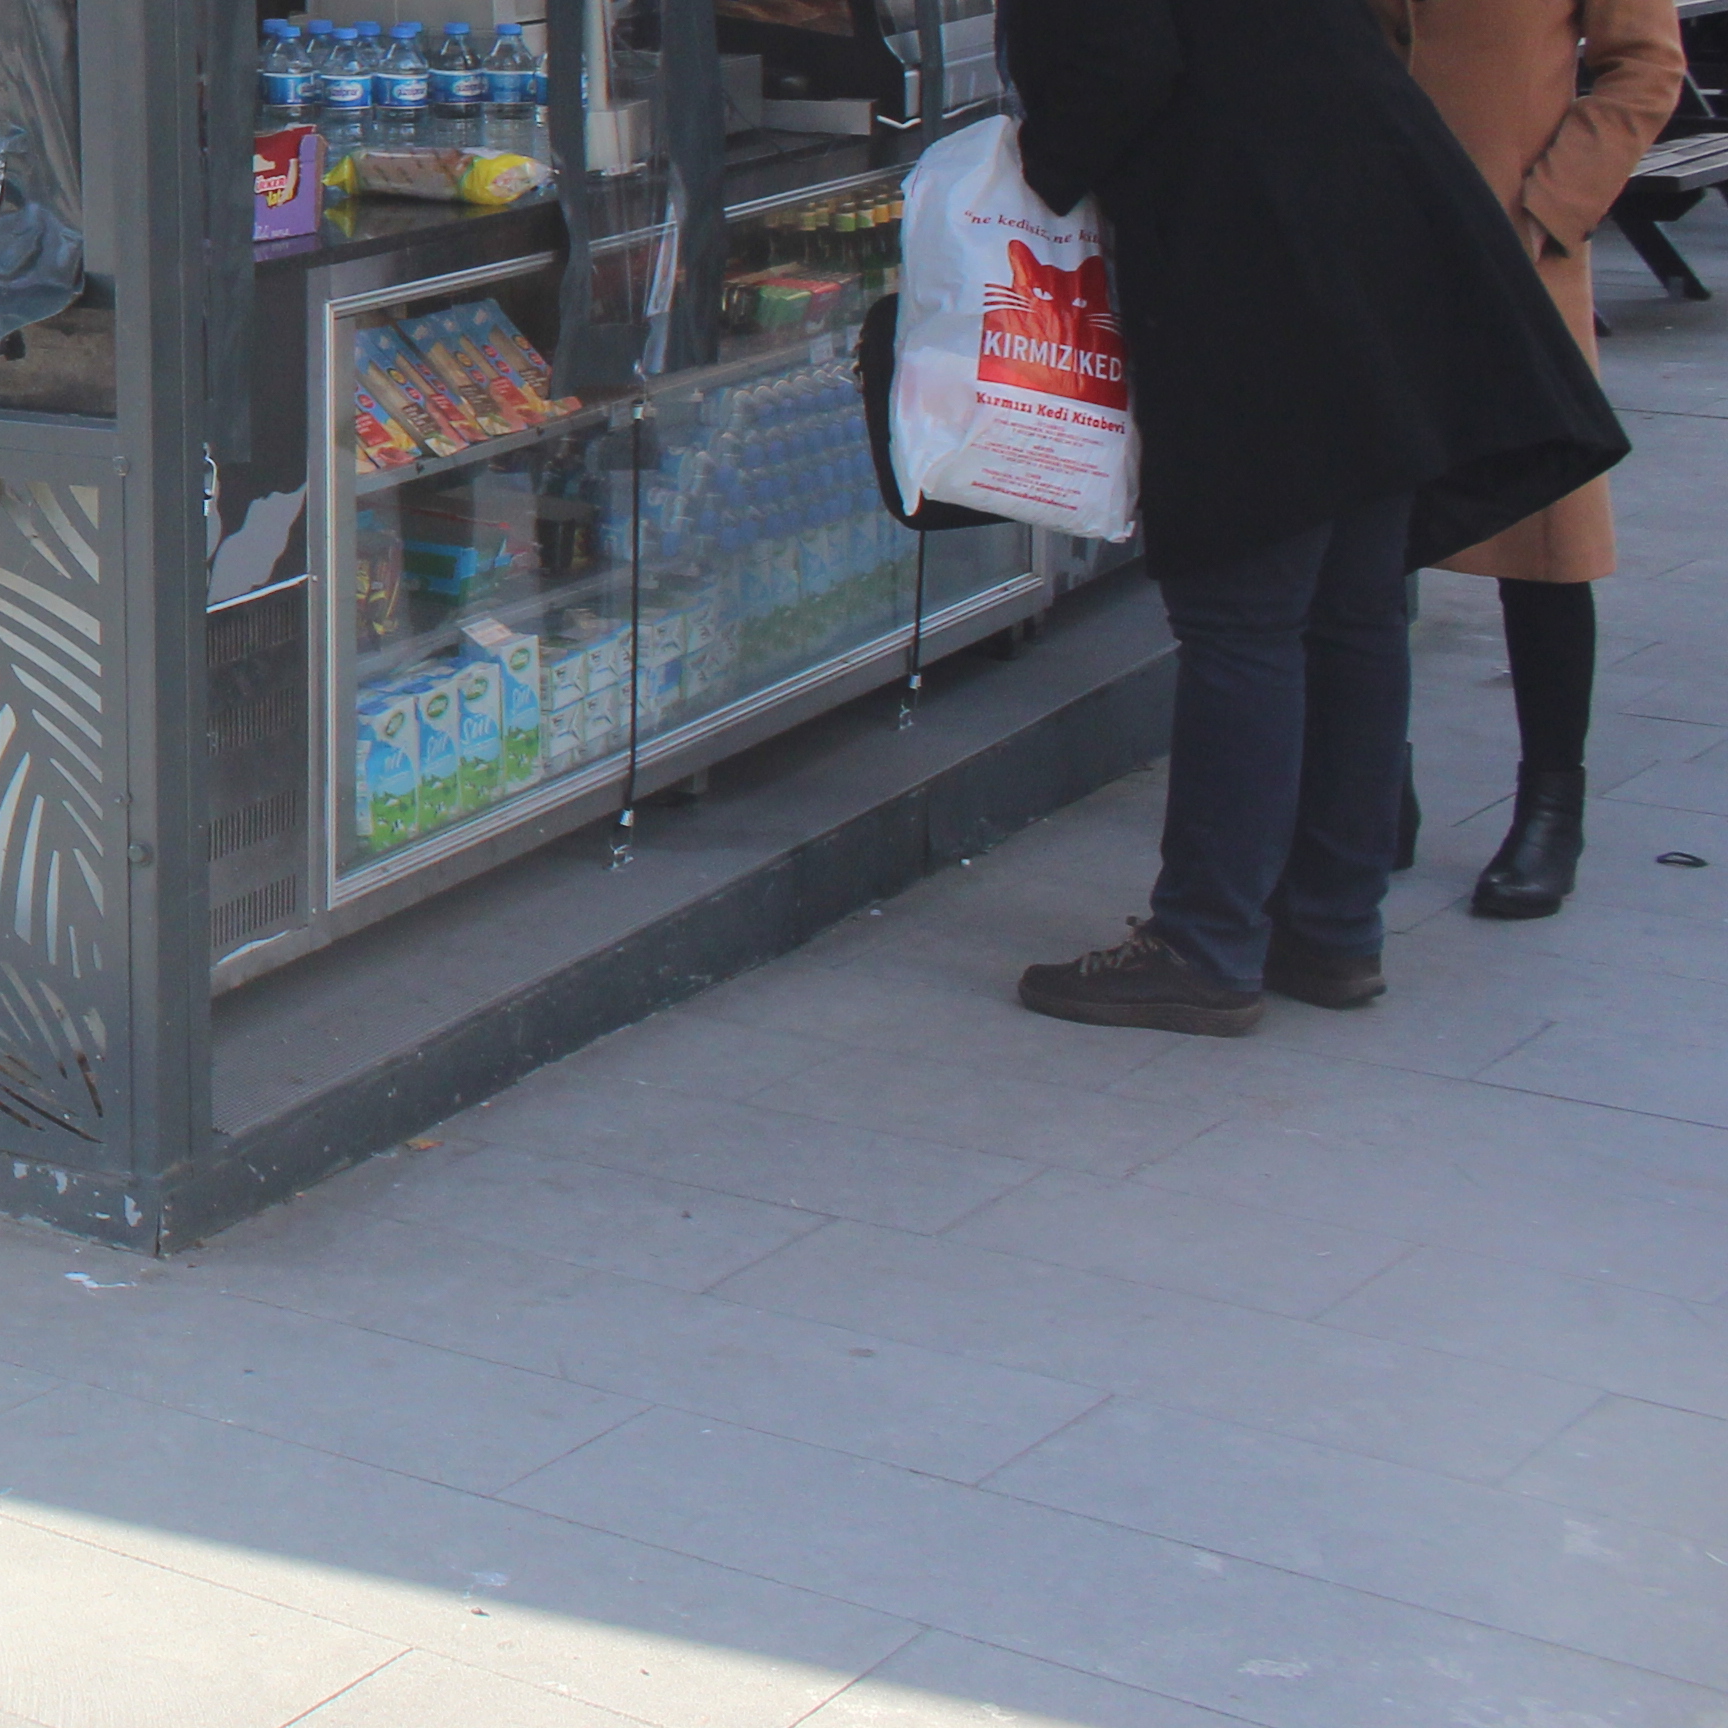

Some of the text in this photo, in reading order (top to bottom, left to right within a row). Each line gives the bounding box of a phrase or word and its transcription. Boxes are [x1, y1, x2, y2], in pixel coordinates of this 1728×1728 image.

[976, 390, 1033, 414] Kırmızı
[1036, 403, 1070, 421] Kedi
[1071, 411, 1126, 434] Kitabevi
